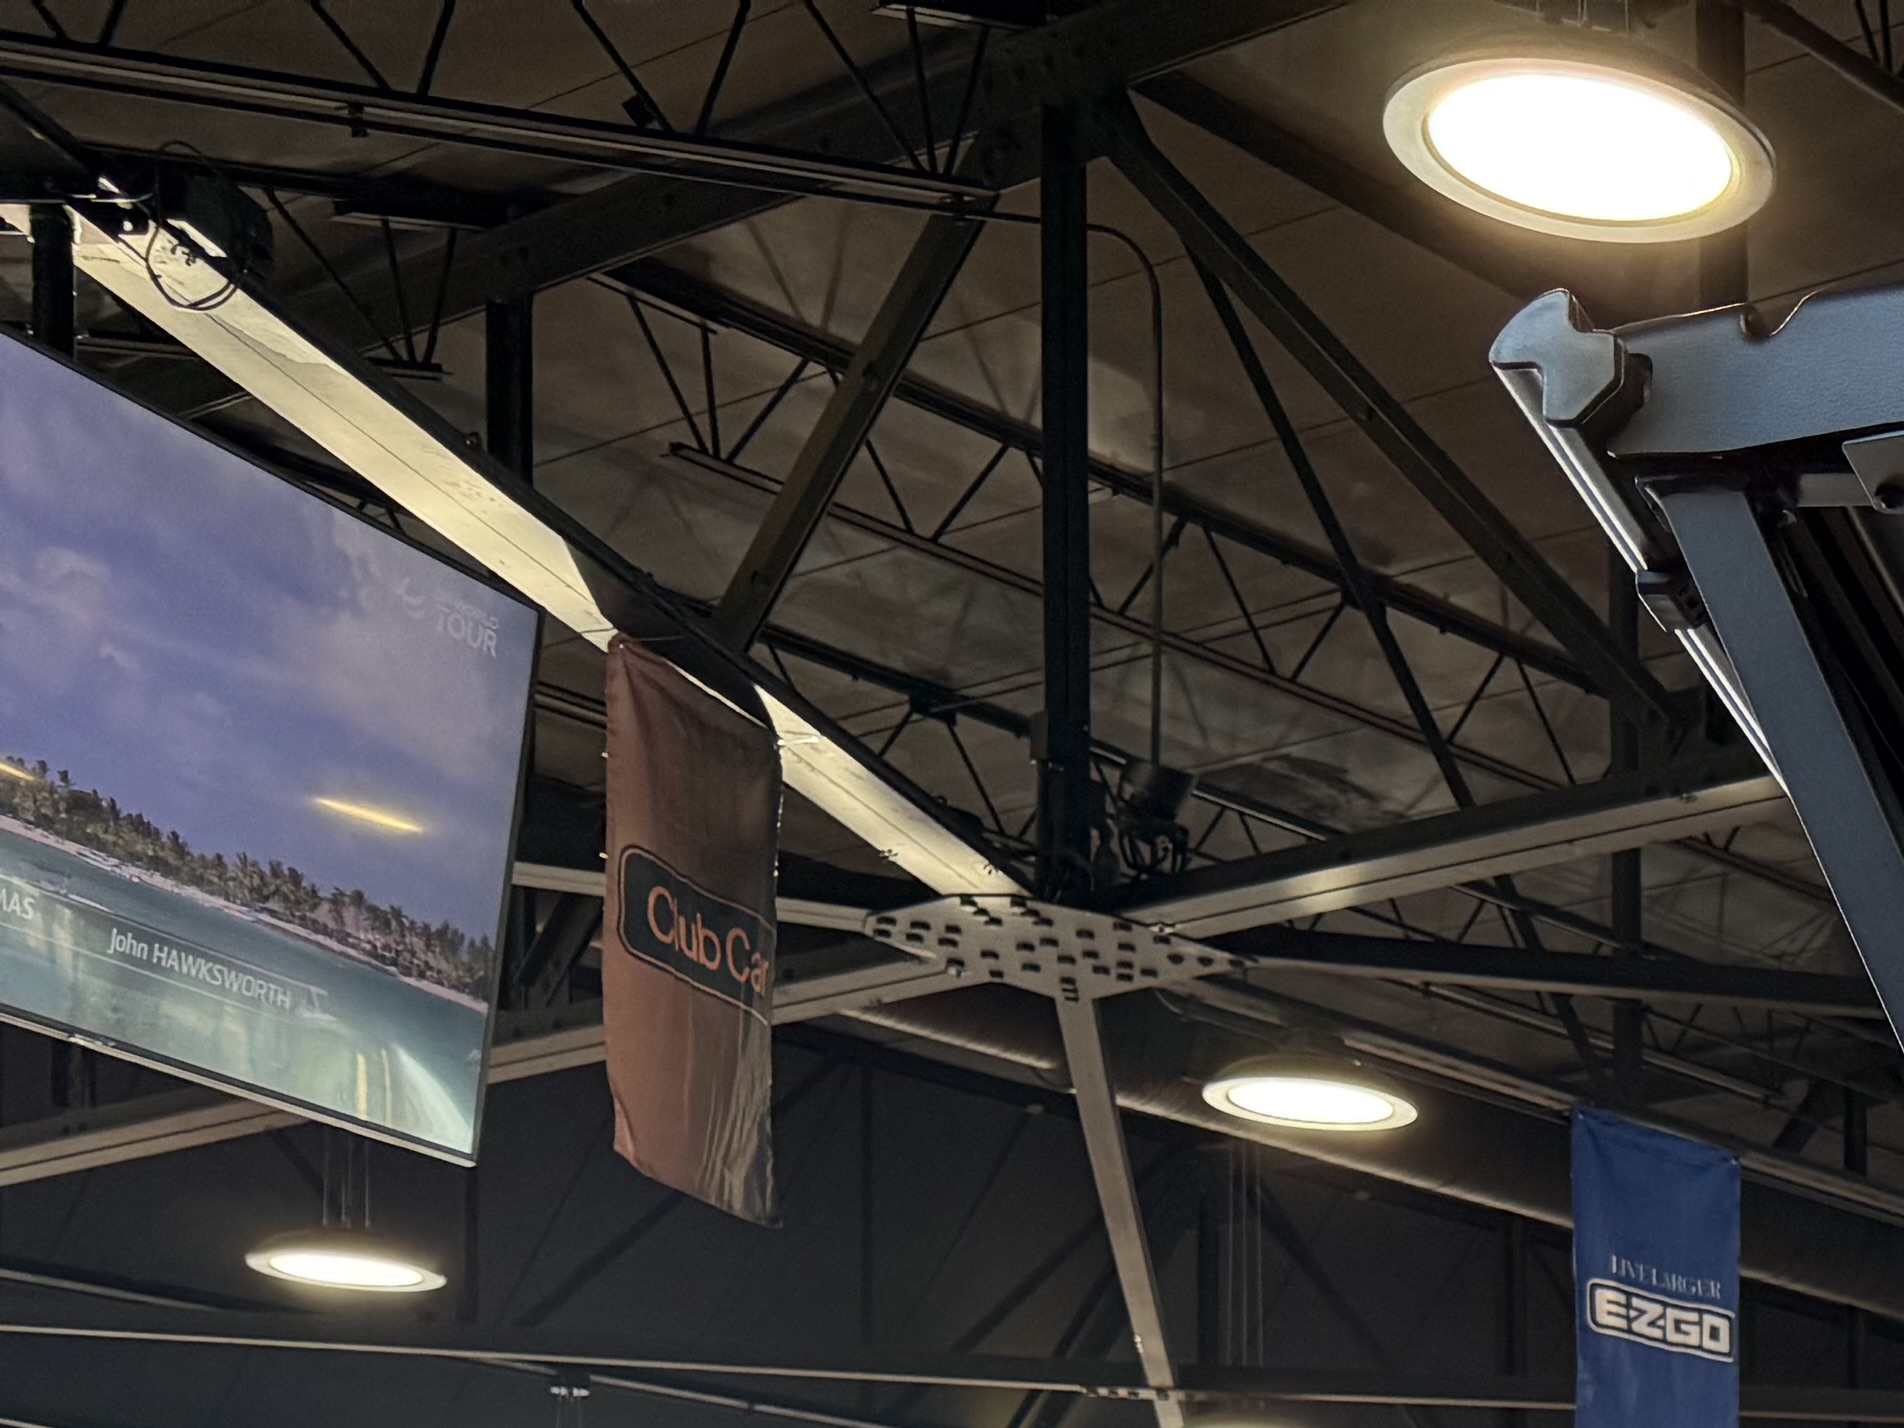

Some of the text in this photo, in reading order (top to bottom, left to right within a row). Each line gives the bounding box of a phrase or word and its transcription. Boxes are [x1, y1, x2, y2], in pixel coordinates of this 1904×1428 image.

[436, 603, 497, 658] TOUR
[647, 886, 721, 970] Club
[107, 928, 290, 1010] John HAWKSWORTH
[1594, 1287, 1731, 1354] EZGO
